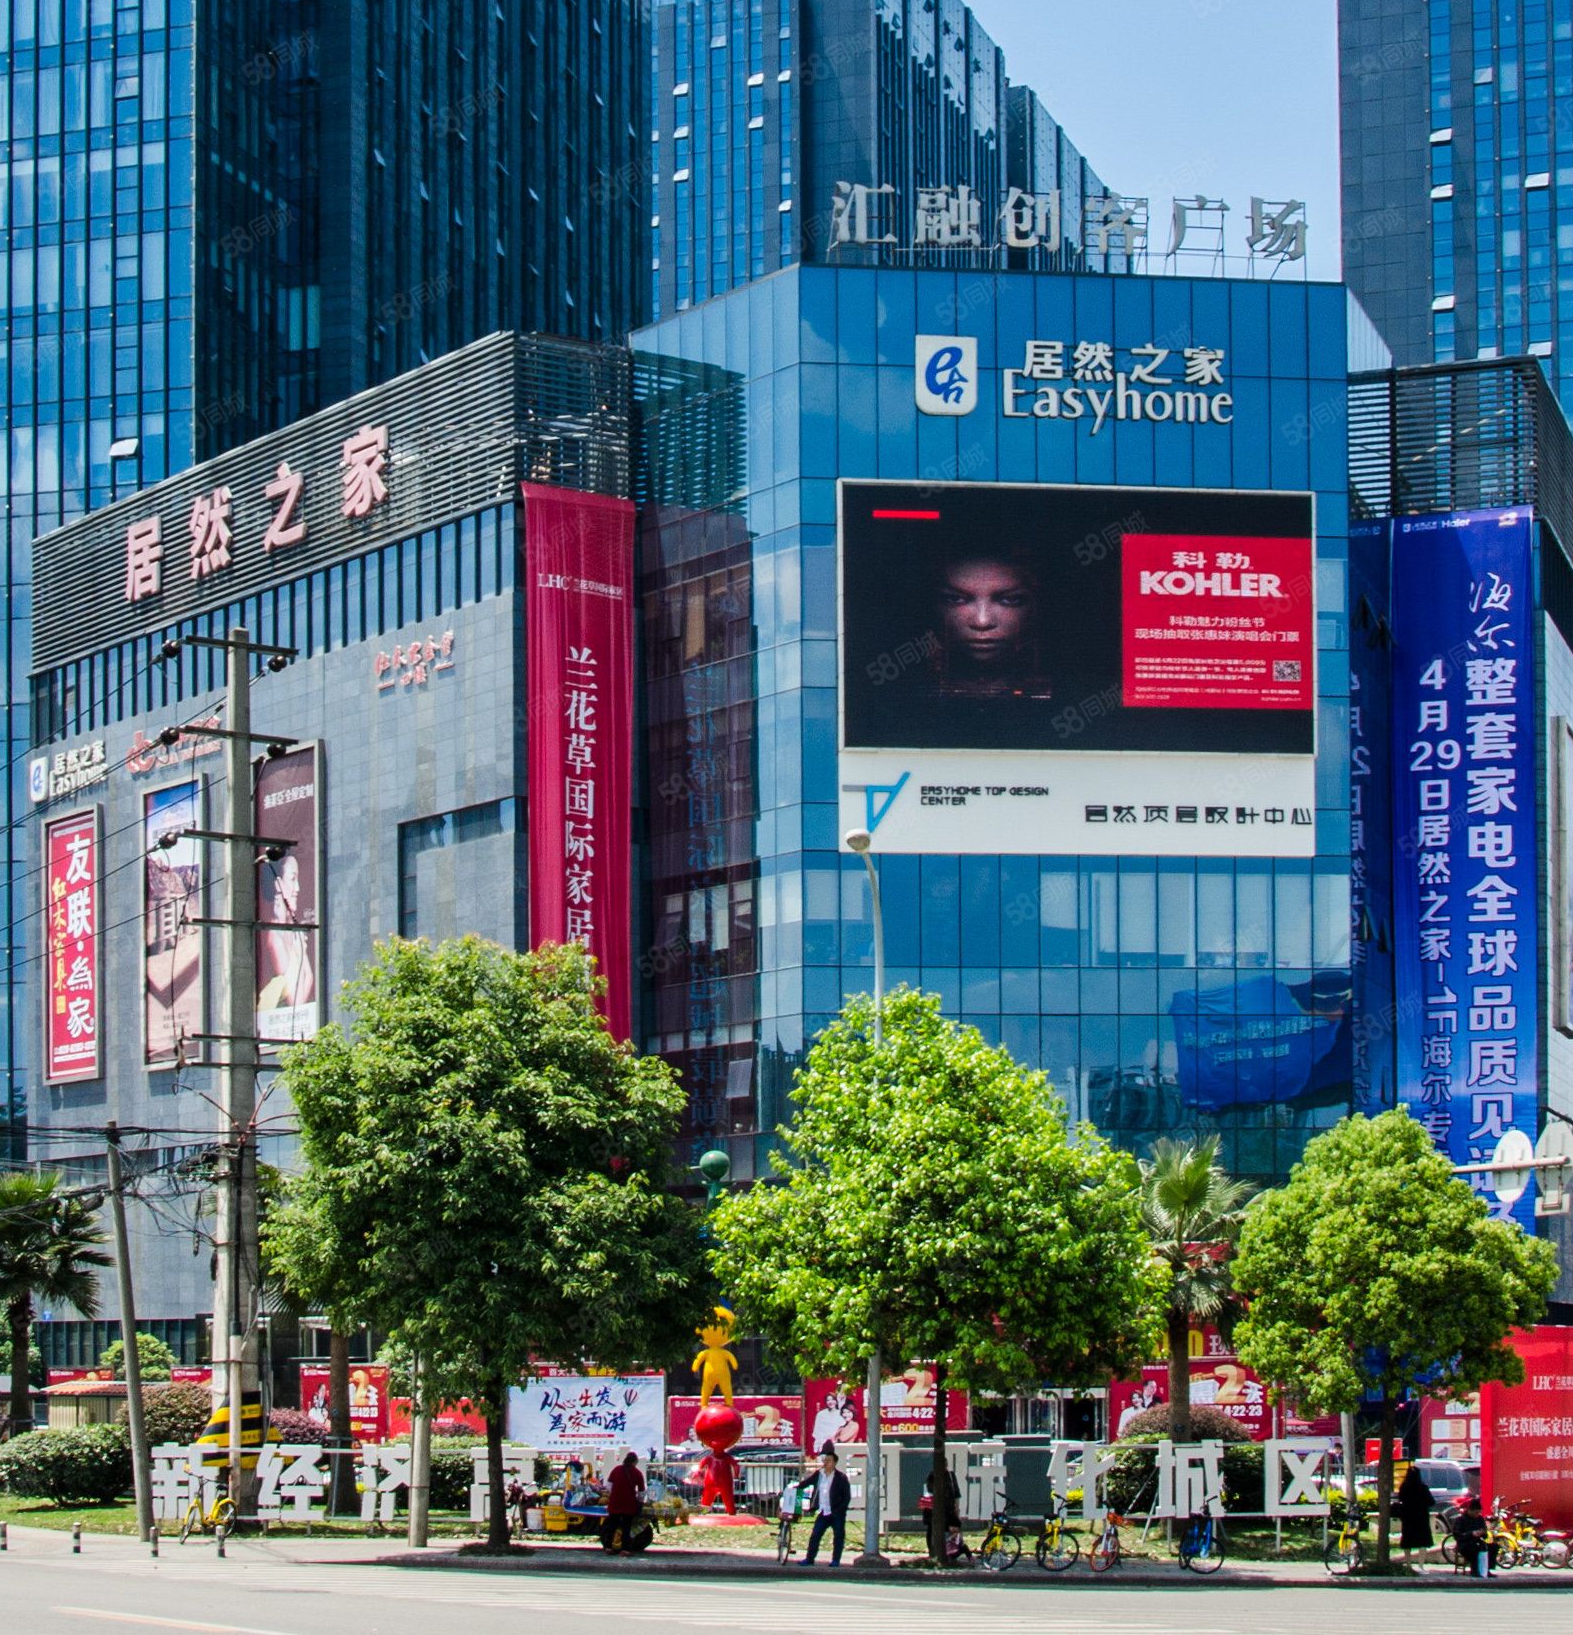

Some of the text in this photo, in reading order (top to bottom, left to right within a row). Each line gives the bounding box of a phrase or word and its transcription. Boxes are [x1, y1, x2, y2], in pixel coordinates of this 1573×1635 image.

[831, 179, 1308, 262] 汇融创客广场
[1022, 338, 1226, 386] 居然之家
[1002, 367, 1234, 436] Easyhome
[125, 423, 390, 602] 居然之家
[1441, 517, 1471, 529] Haier
[1172, 551, 1252, 570] 科勒
[538, 572, 571, 590] LHC
[1139, 570, 1285, 598] KOHLER
[920, 785, 1049, 797] EASYHOME TOP DESIGN
[920, 796, 967, 806] CENTER
[1532, 1375, 1554, 1391] LHC
[539, 1385, 616, 1412] 从心出发
